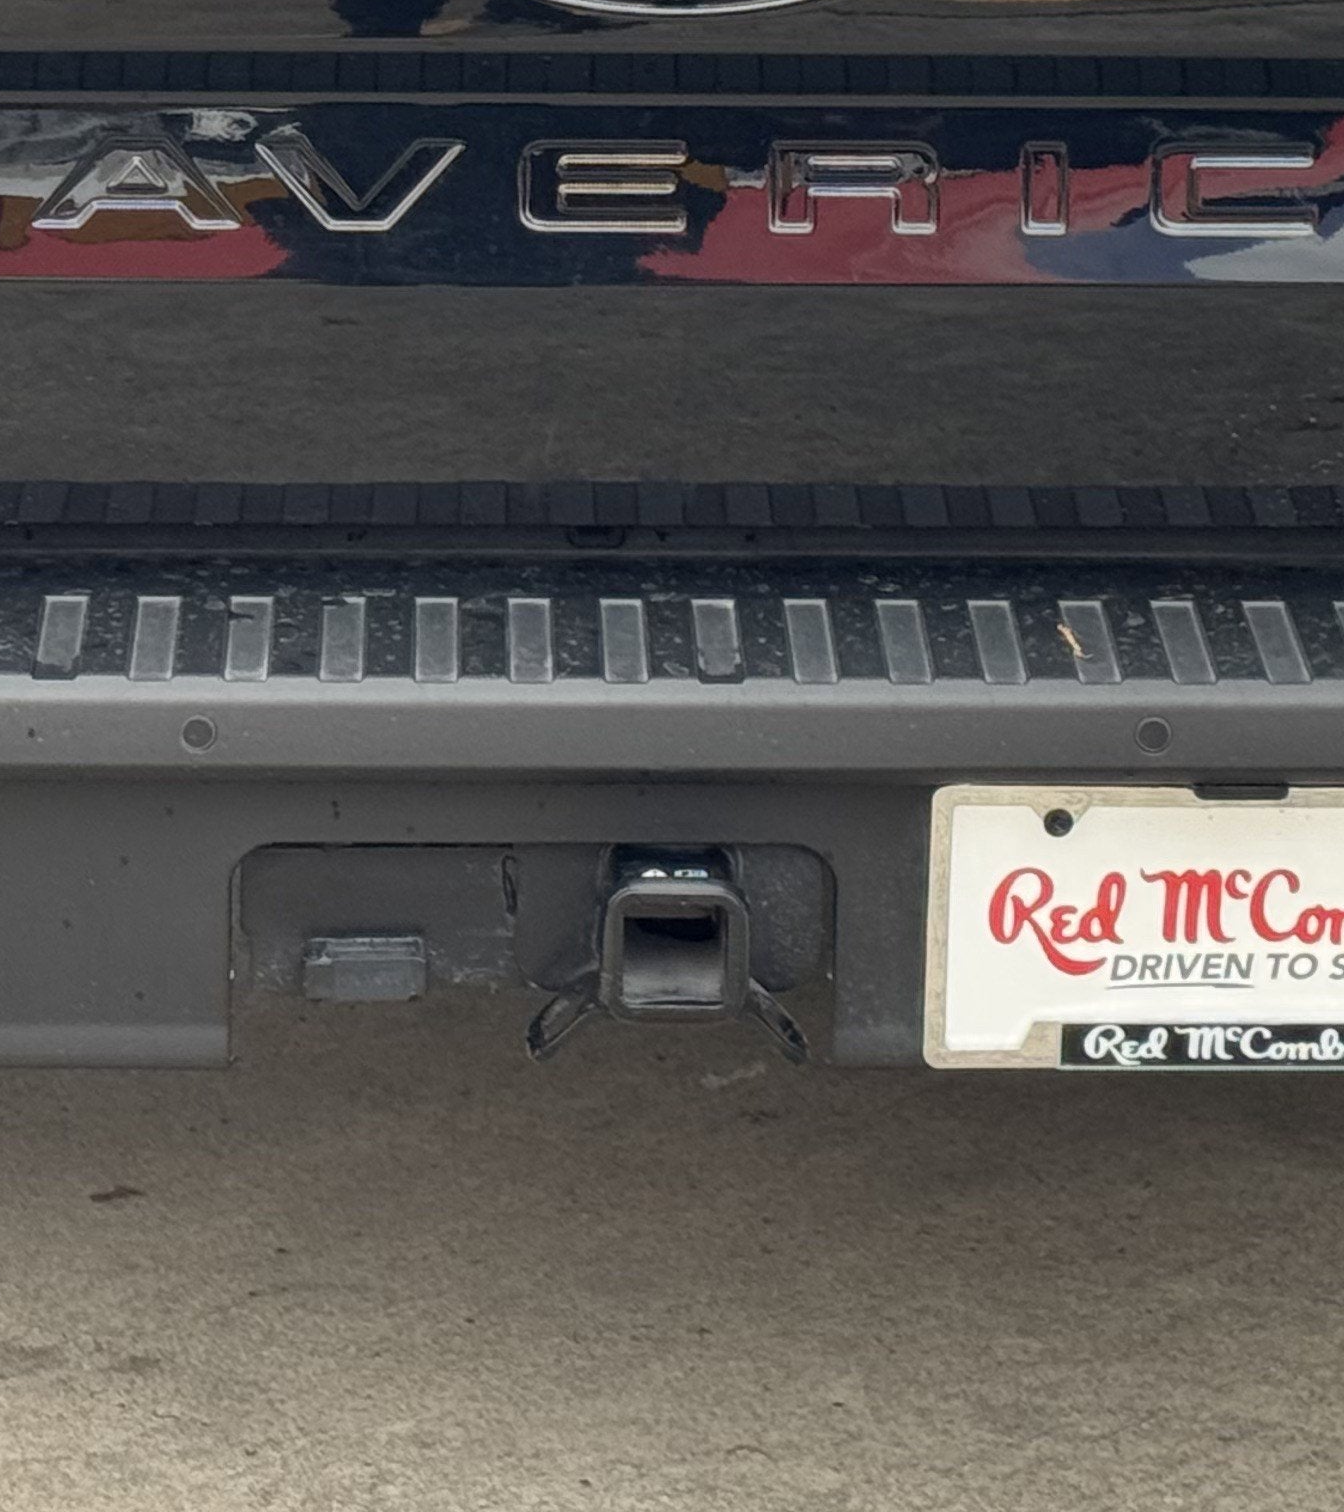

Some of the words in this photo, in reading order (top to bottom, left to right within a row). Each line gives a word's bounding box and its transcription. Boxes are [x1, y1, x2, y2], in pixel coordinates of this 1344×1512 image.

[989, 867, 1127, 976] Red
[1111, 952, 1255, 982] DRIVEN
[1267, 952, 1319, 981] TO
[1084, 1024, 1167, 1065] Red
